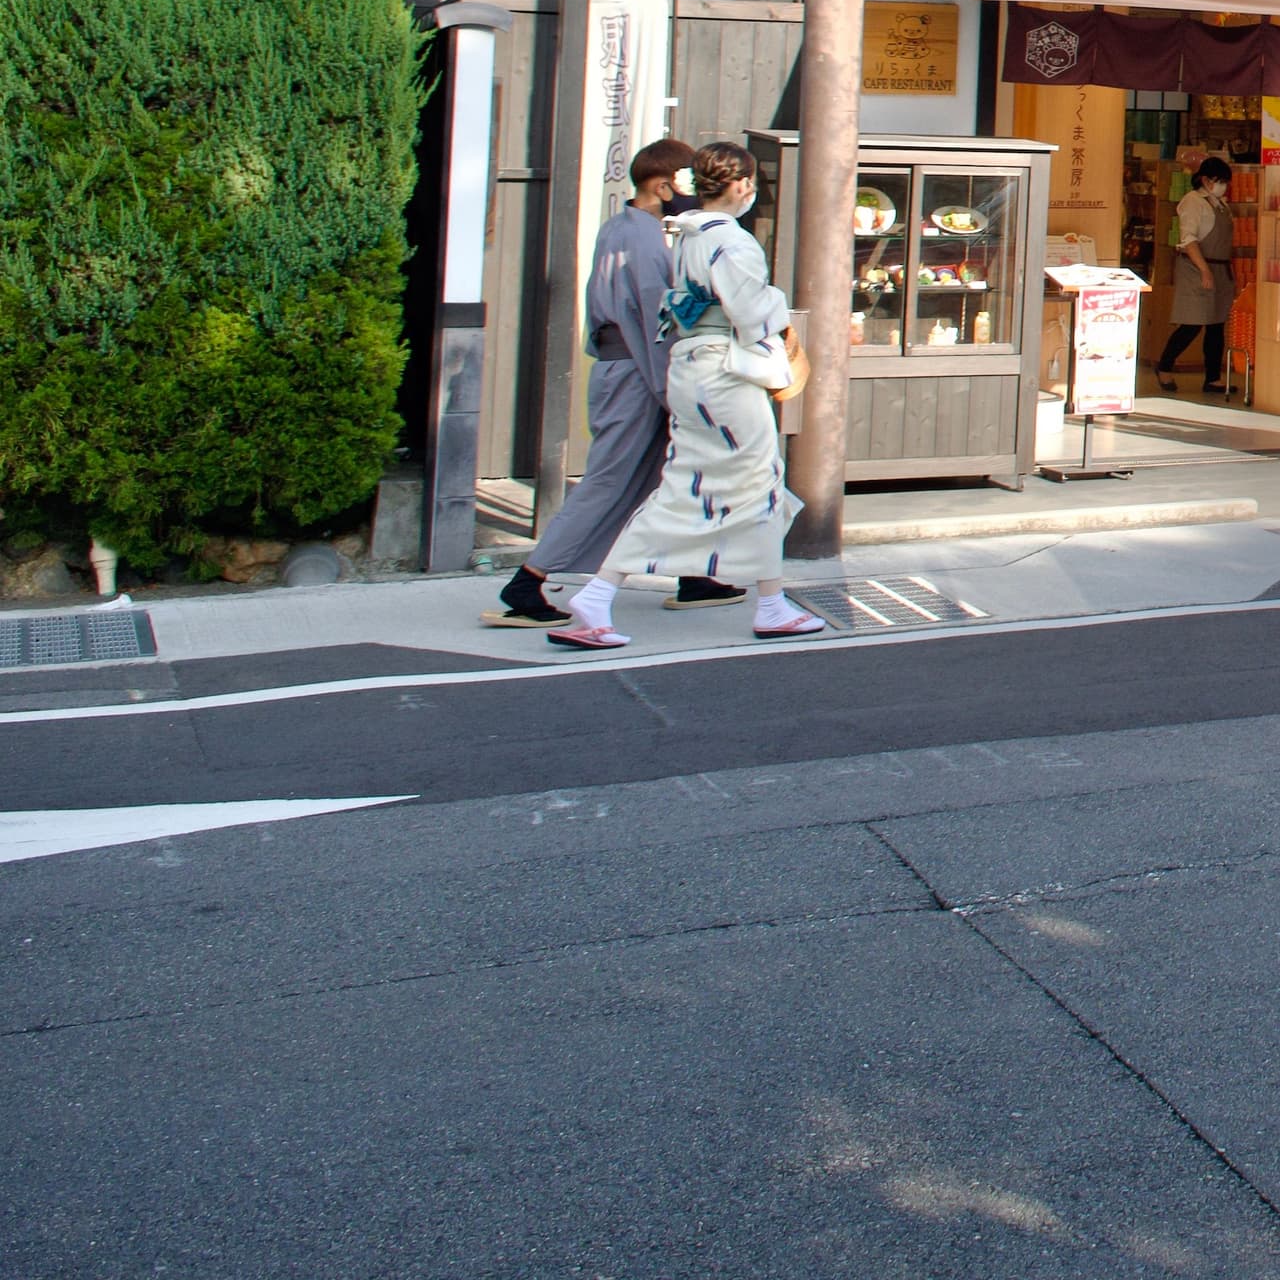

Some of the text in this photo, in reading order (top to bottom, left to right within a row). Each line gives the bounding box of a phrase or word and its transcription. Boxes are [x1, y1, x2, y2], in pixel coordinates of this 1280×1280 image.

[876, 62, 937, 76] りらっくま
[863, 78, 953, 91] CAFE RESTAURANT
[1070, 85, 1087, 187] っくま茶房
